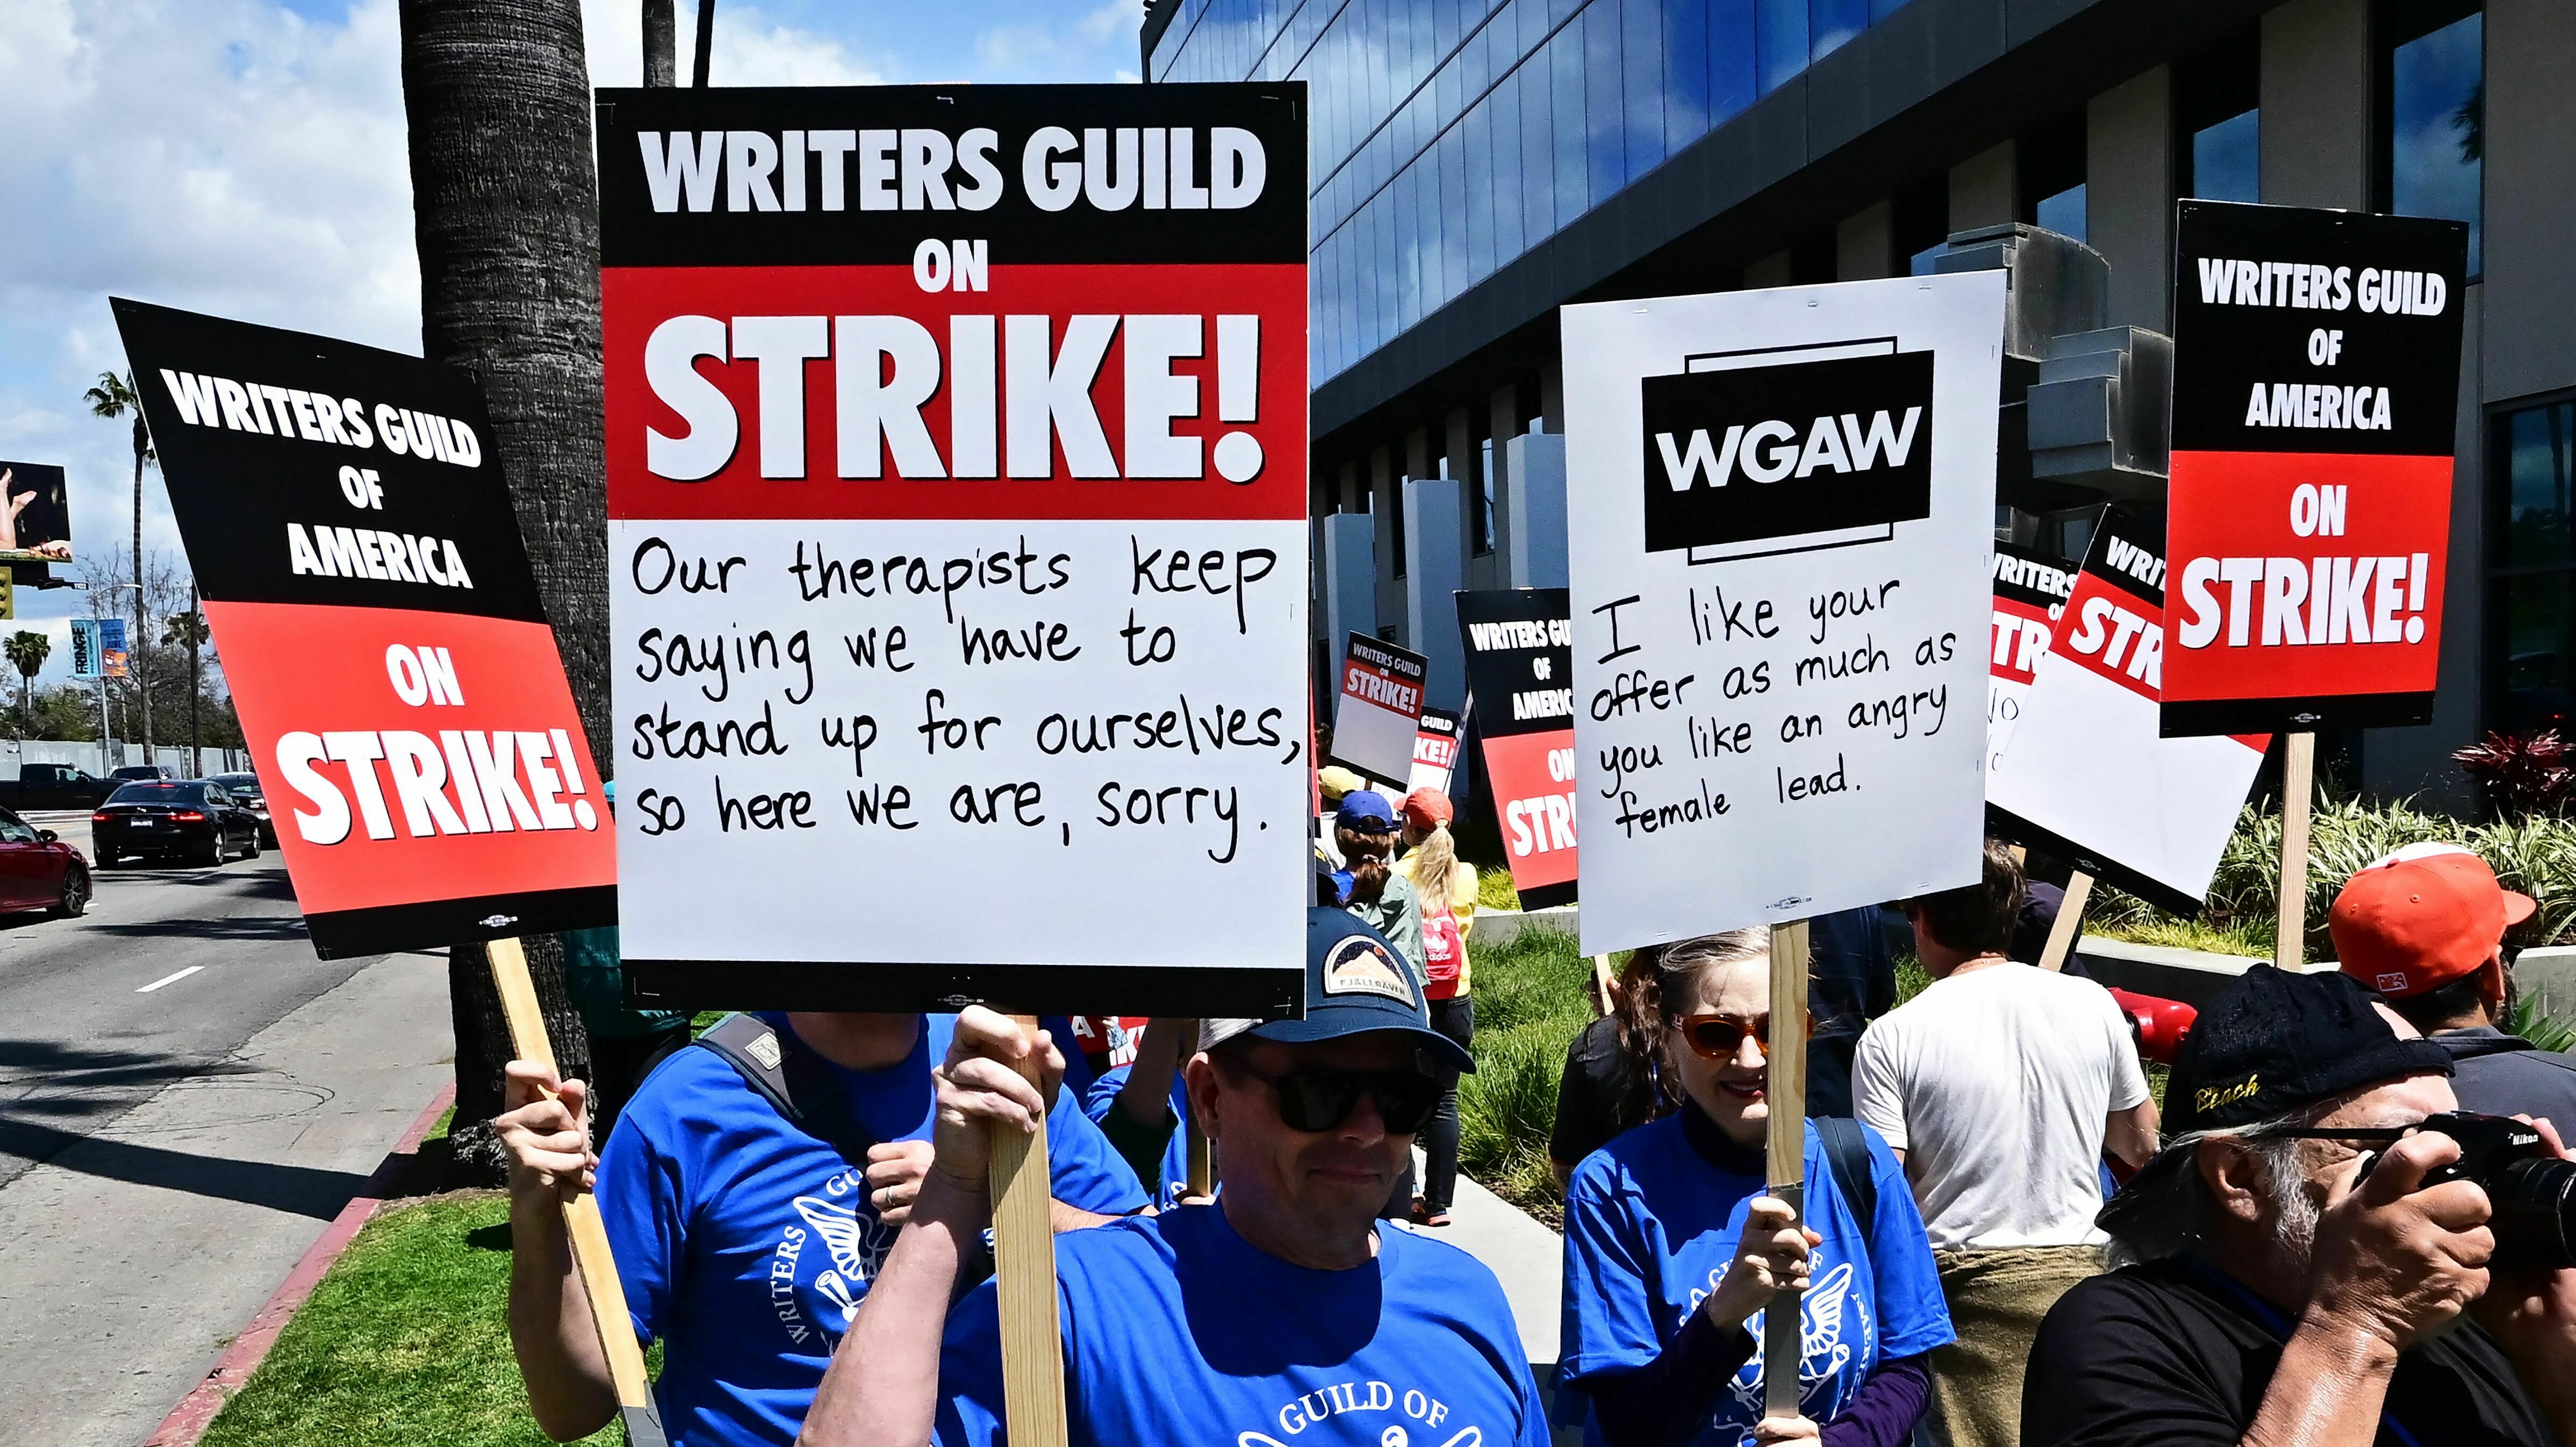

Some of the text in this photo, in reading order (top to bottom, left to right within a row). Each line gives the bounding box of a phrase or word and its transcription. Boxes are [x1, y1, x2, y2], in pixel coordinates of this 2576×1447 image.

[638, 126, 1267, 213] WRITERS GUILD
[913, 239, 988, 293] ON
[2198, 258, 2446, 316] WRITERS GUILD
[2308, 328, 2343, 366] OF
[160, 369, 482, 468] WRITERS GUILD
[644, 314, 1265, 484] STRIKE!
[2245, 382, 2392, 430] AMERICA
[1655, 406, 1922, 492] WGAW
[339, 466, 384, 510] OF
[2290, 483, 2348, 538] ON
[287, 523, 473, 589] AMERICA
[632, 535, 1278, 633] Our therapists keep
[1591, 578, 1900, 665] I like your
[2178, 552, 2430, 649] STRIKE!
[72, 627, 88, 674] FRINGE
[637, 607, 1176, 704] saying we have to
[1353, 642, 1421, 677] WRITERS GUILD
[1469, 620, 1548, 651] WRITERS
[386, 643, 464, 708] ON
[1346, 667, 1418, 714] STRIKE!
[1533, 658, 1552, 680] OF
[1590, 630, 1956, 722] offer as much as
[633, 689, 1302, 778] stand up for ourselves,
[1420, 715, 1453, 731] GUILD
[1600, 683, 1947, 798] you like an angry
[276, 728, 598, 846] STRIKE!
[637, 775, 1268, 863] so here we are, sorry.
[1615, 752, 1862, 838] female lead.
[2194, 1074, 2261, 1113] Beach
[2513, 1134, 2538, 1146] Nikon
[770, 1225, 810, 1345] WRITERS
[1279, 1380, 1449, 1435] GUILD OF
